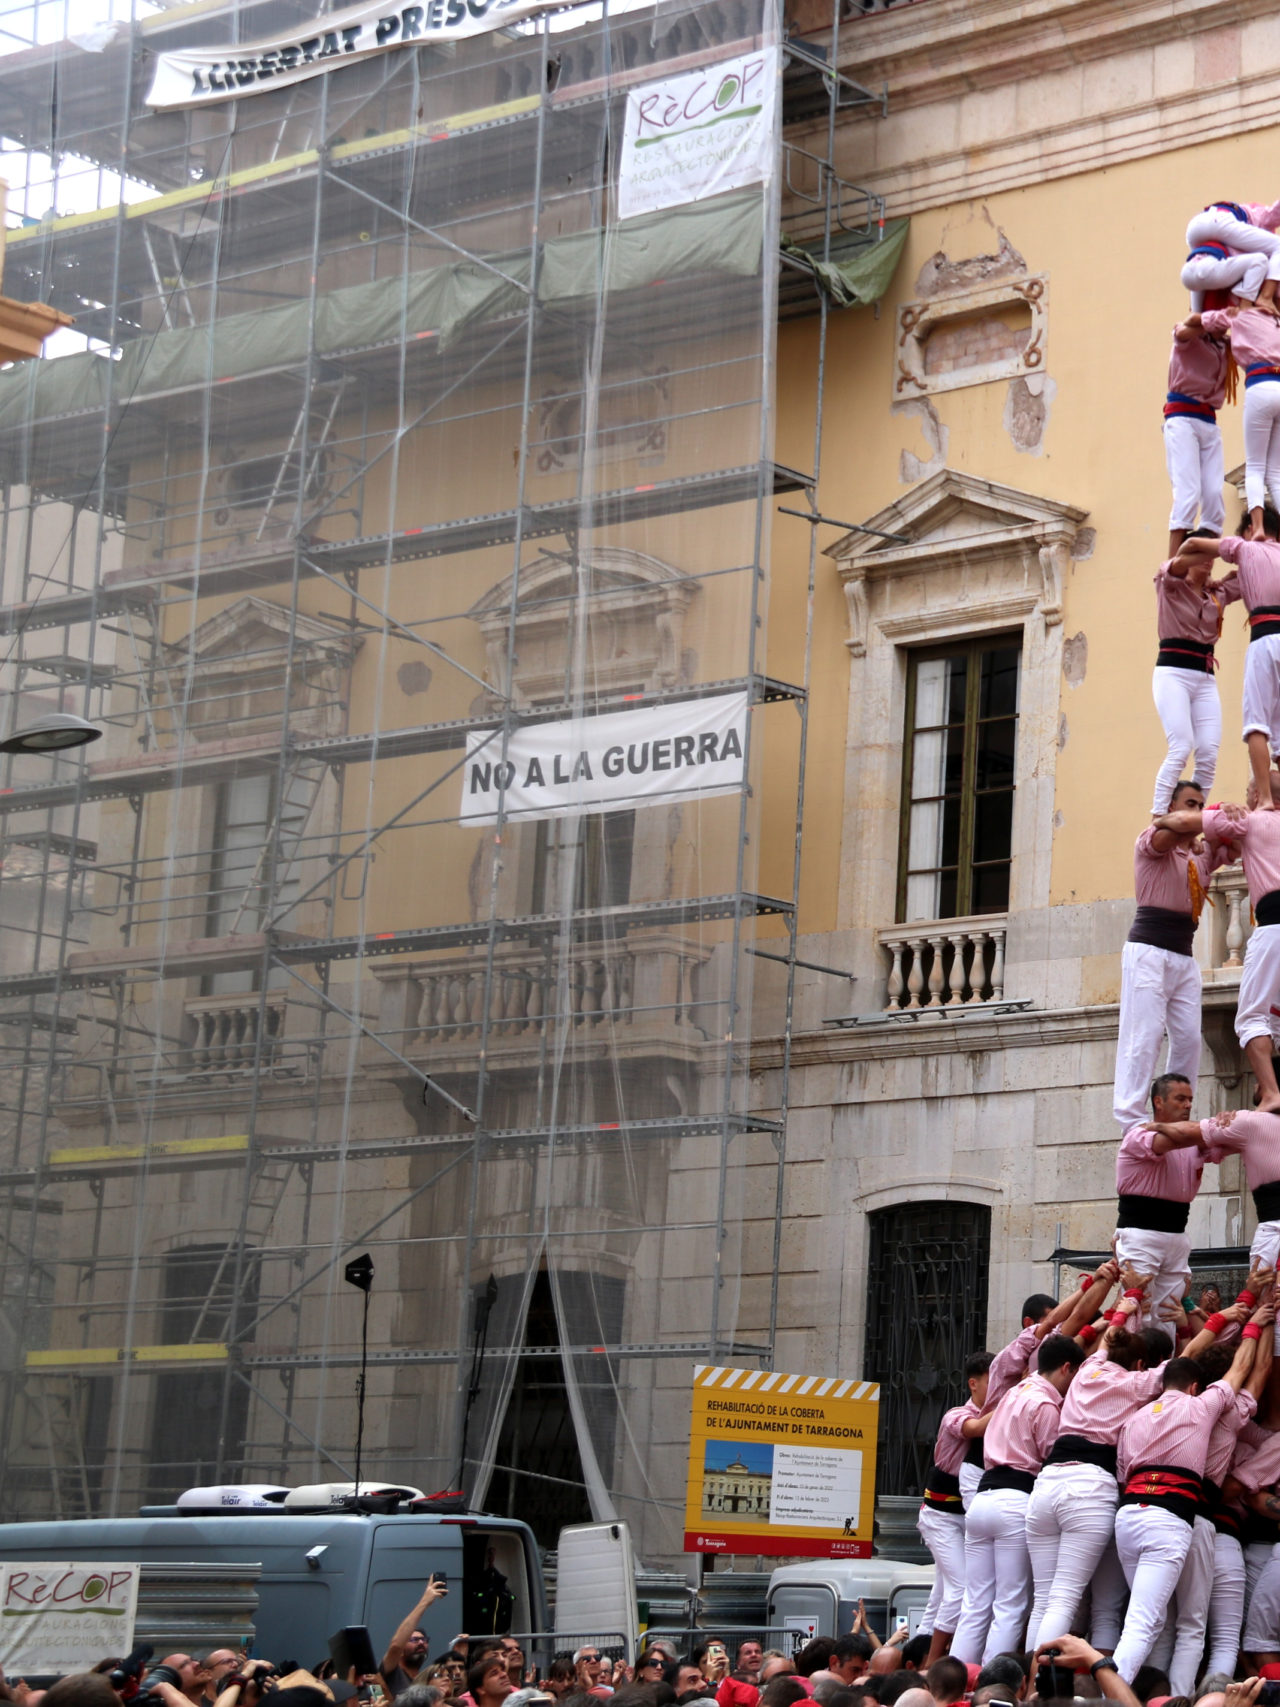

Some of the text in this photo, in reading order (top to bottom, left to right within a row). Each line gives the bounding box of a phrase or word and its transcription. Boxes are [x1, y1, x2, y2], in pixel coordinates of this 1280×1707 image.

[191, 0, 517, 97] LLIBERTAT PRESO
[470, 728, 743, 794] NO A LA GUERRA
[706, 1417, 863, 1439] DE L'AJUNTAMENT DE TARRAGONA
[707, 1400, 825, 1420] REHABILITACIÓ DE LA COBERTA
